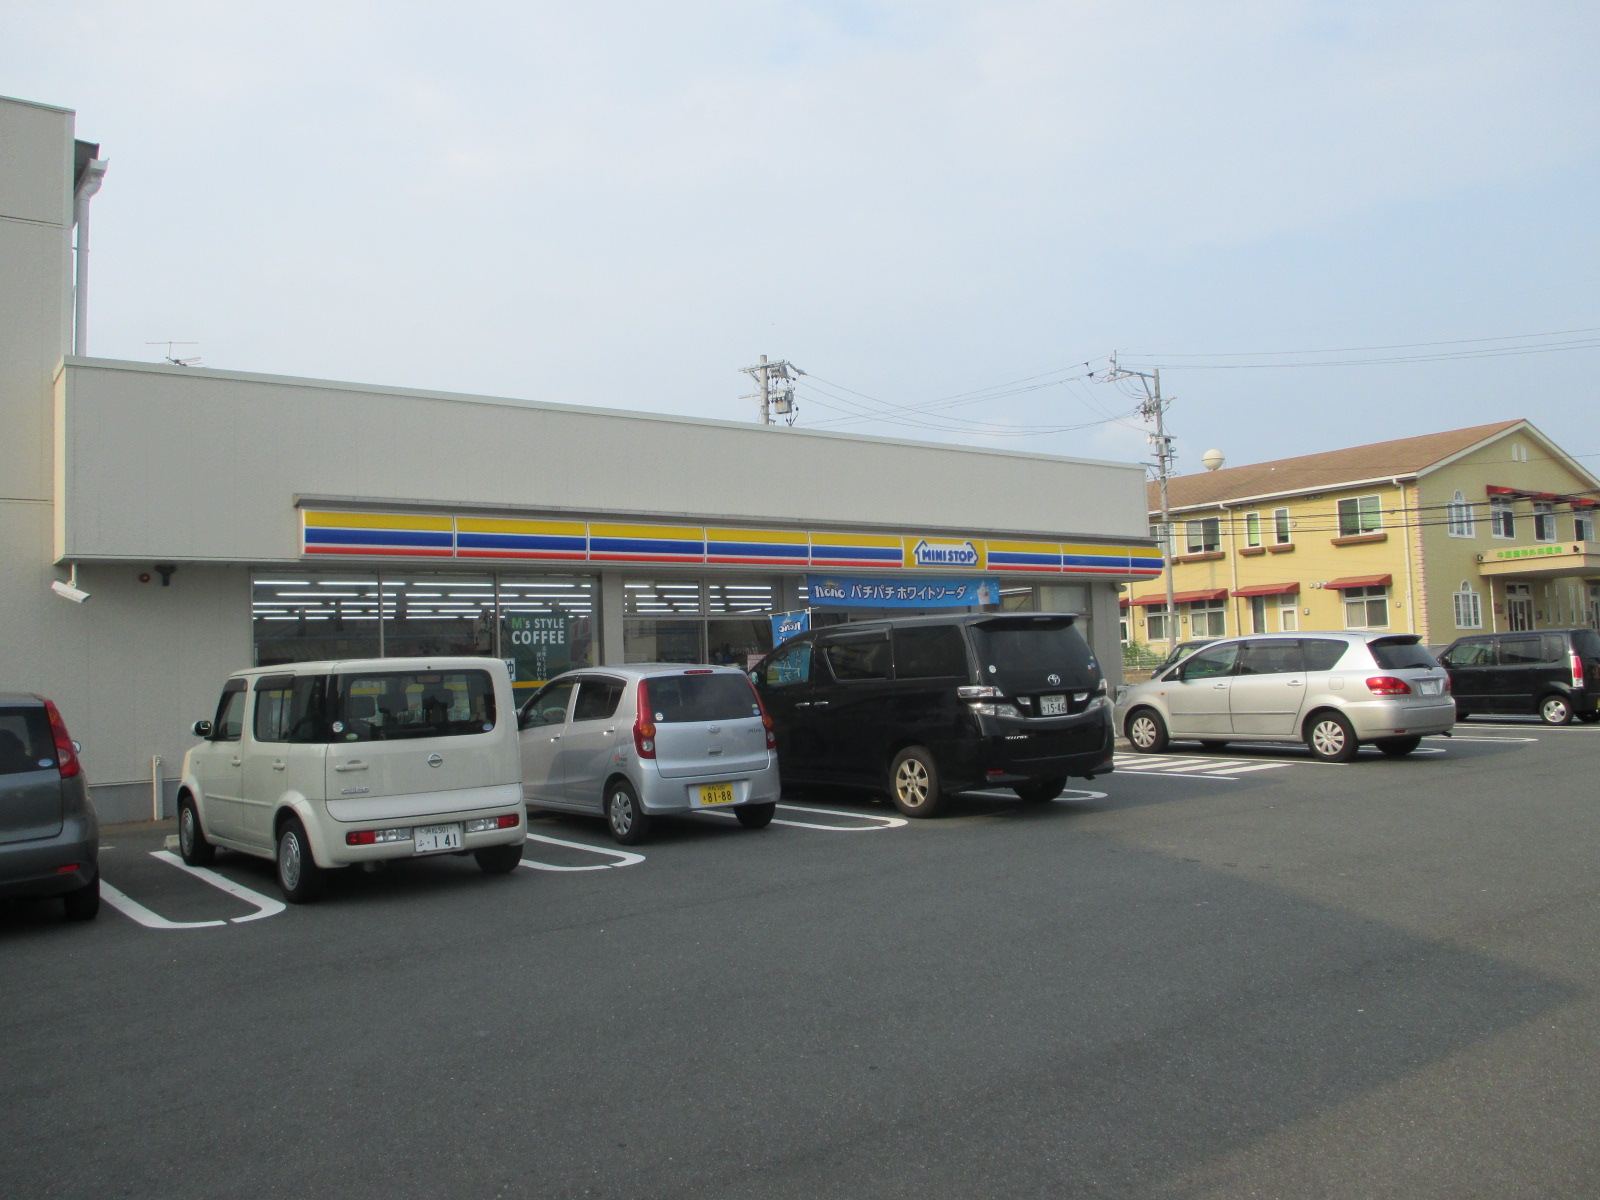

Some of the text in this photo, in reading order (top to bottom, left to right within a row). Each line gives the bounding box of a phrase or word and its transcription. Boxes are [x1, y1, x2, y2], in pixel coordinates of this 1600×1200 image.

[511, 617, 565, 629] M's STYLE
[511, 630, 565, 645] COFFEE
[707, 790, 732, 803] 81-88
